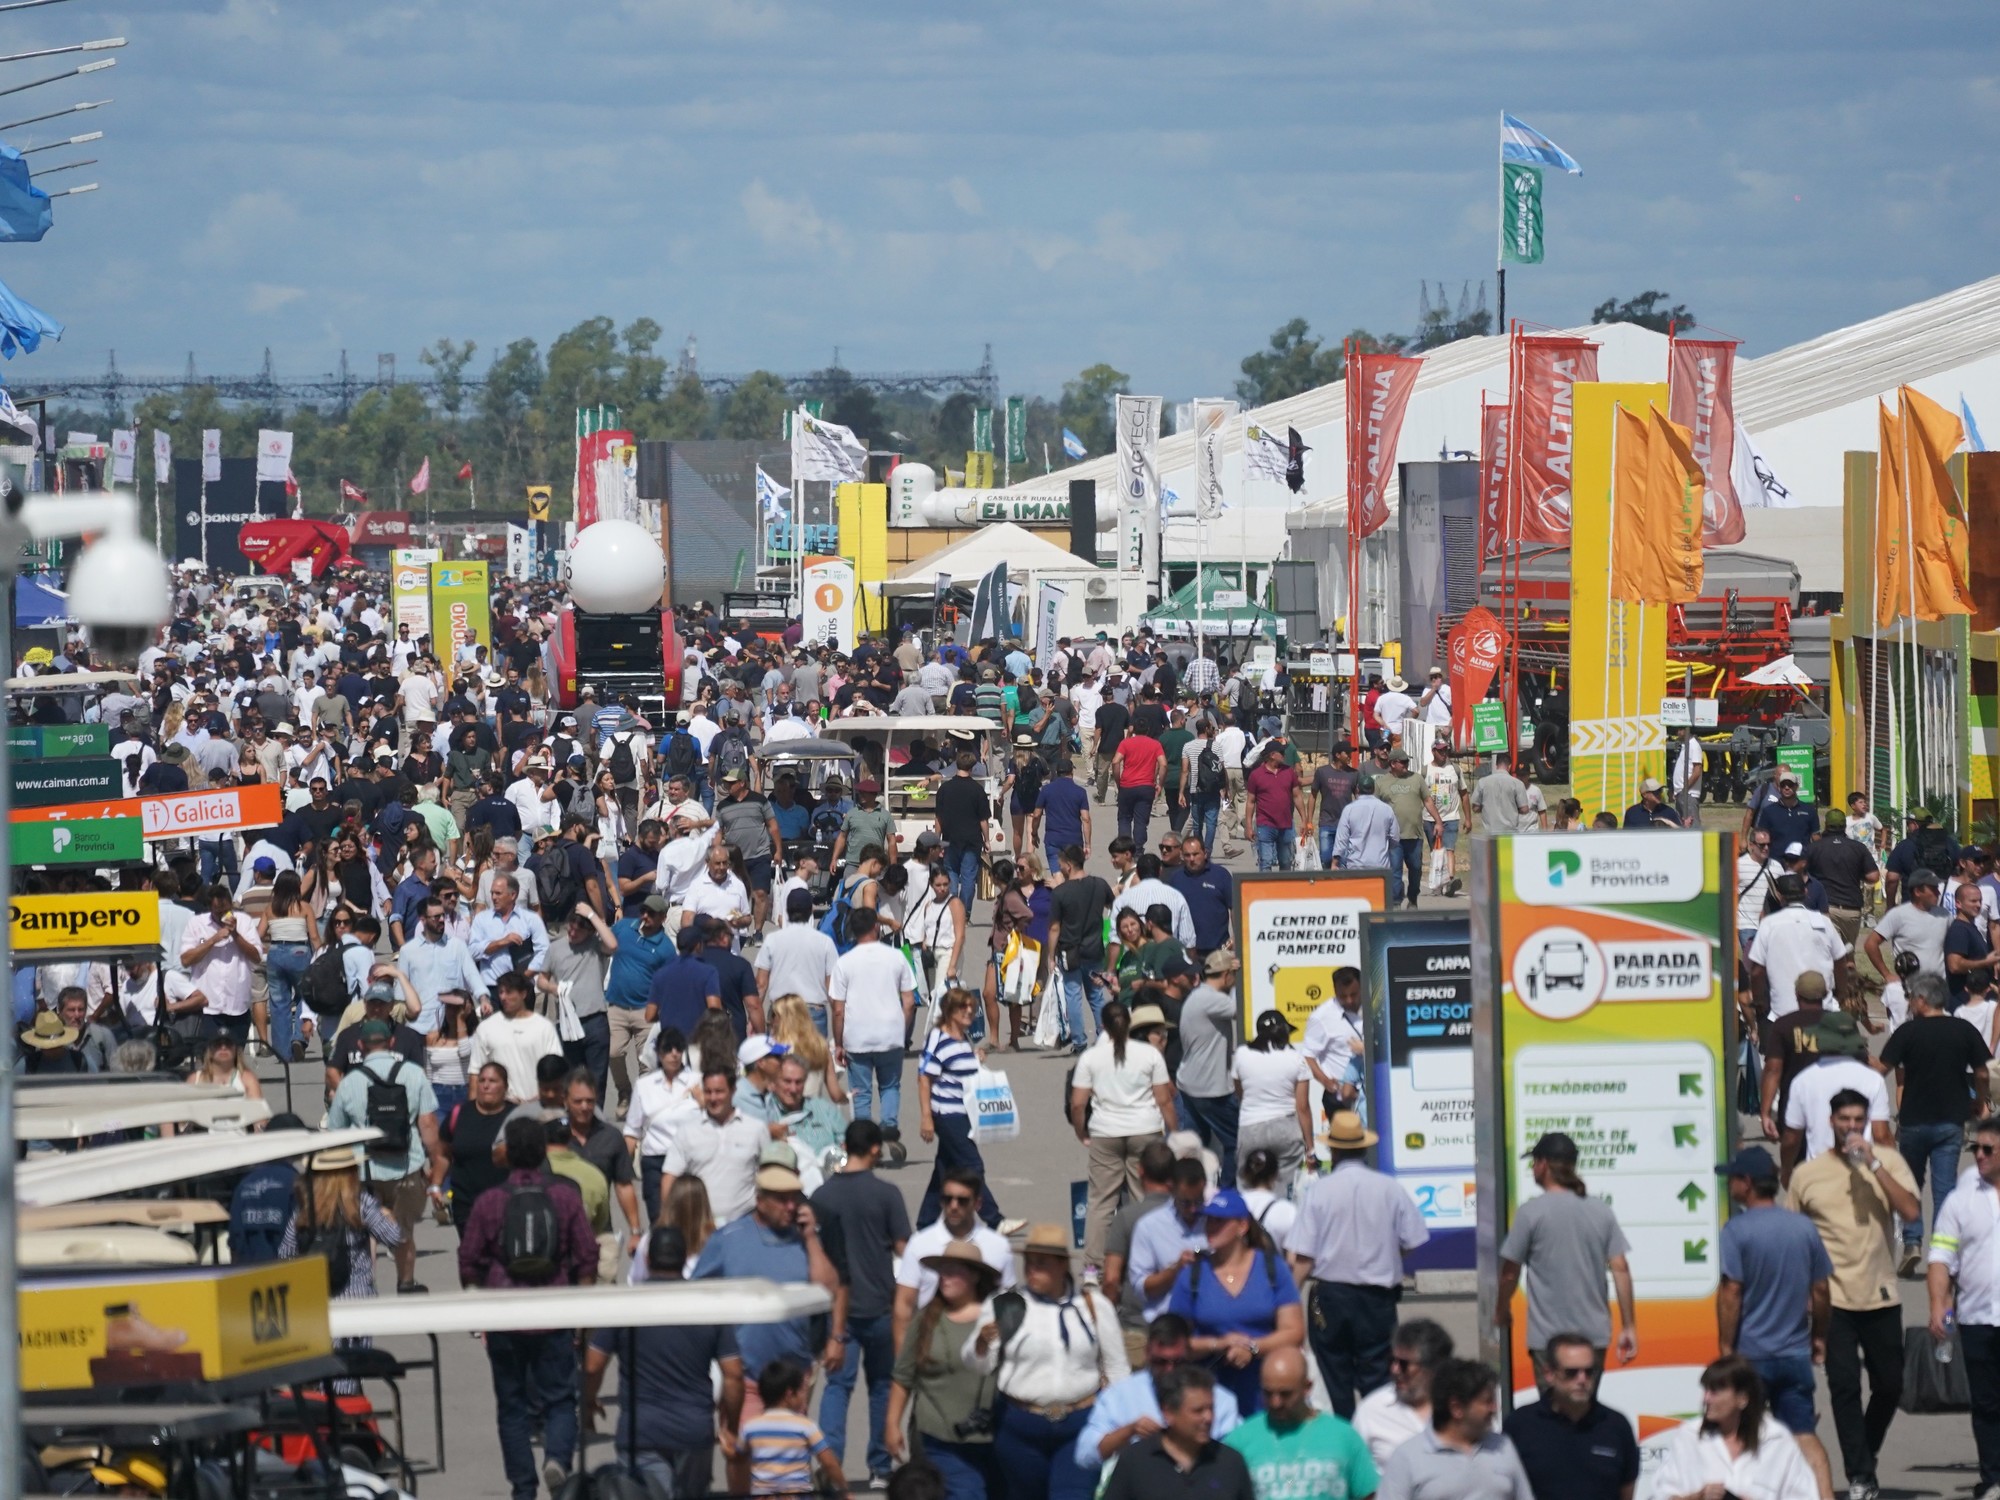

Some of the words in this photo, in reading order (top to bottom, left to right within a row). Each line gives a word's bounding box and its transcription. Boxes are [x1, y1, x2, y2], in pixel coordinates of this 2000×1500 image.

[1368, 369, 1396, 477] ALTINA
[1546, 358, 1577, 479] ALTINA
[1131, 400, 1145, 478] AGTECH
[1488, 418, 1507, 522] ALTINA
[983, 502, 1007, 519] EL
[1013, 502, 1073, 519] IMAN
[1682, 516, 1692, 534] La
[824, 589, 834, 606] 1
[1470, 656, 1495, 669] ALTINA
[72, 733, 94, 746] agro
[16, 776, 110, 790] www.caiman.com.ar
[174, 799, 234, 823] Galicia
[74, 832, 101, 843] Banco
[74, 841, 115, 852] Provincia
[1590, 857, 1641, 873] Banco
[1590, 873, 1669, 887] Provincia
[1272, 914, 1328, 927] CENTRO
[1331, 914, 1349, 926] DE
[1276, 943, 1346, 956] PAMPERO
[1426, 957, 1471, 971] CARPA
[1613, 953, 1702, 970] PARADA
[1615, 974, 1650, 989] BUS
[1655, 974, 1702, 988] STOP
[1405, 987, 1457, 1001] ESPACIO
[1524, 1080, 1628, 1096] TECNÓDROMO
[978, 1099, 1012, 1113] OMBU
[1421, 1100, 1474, 1112] AUDITOR
[1525, 1116, 1571, 1129] SHOW
[1575, 1116, 1594, 1128] DE
[1611, 1129, 1629, 1142] DE
[250, 1284, 290, 1344] CAT
